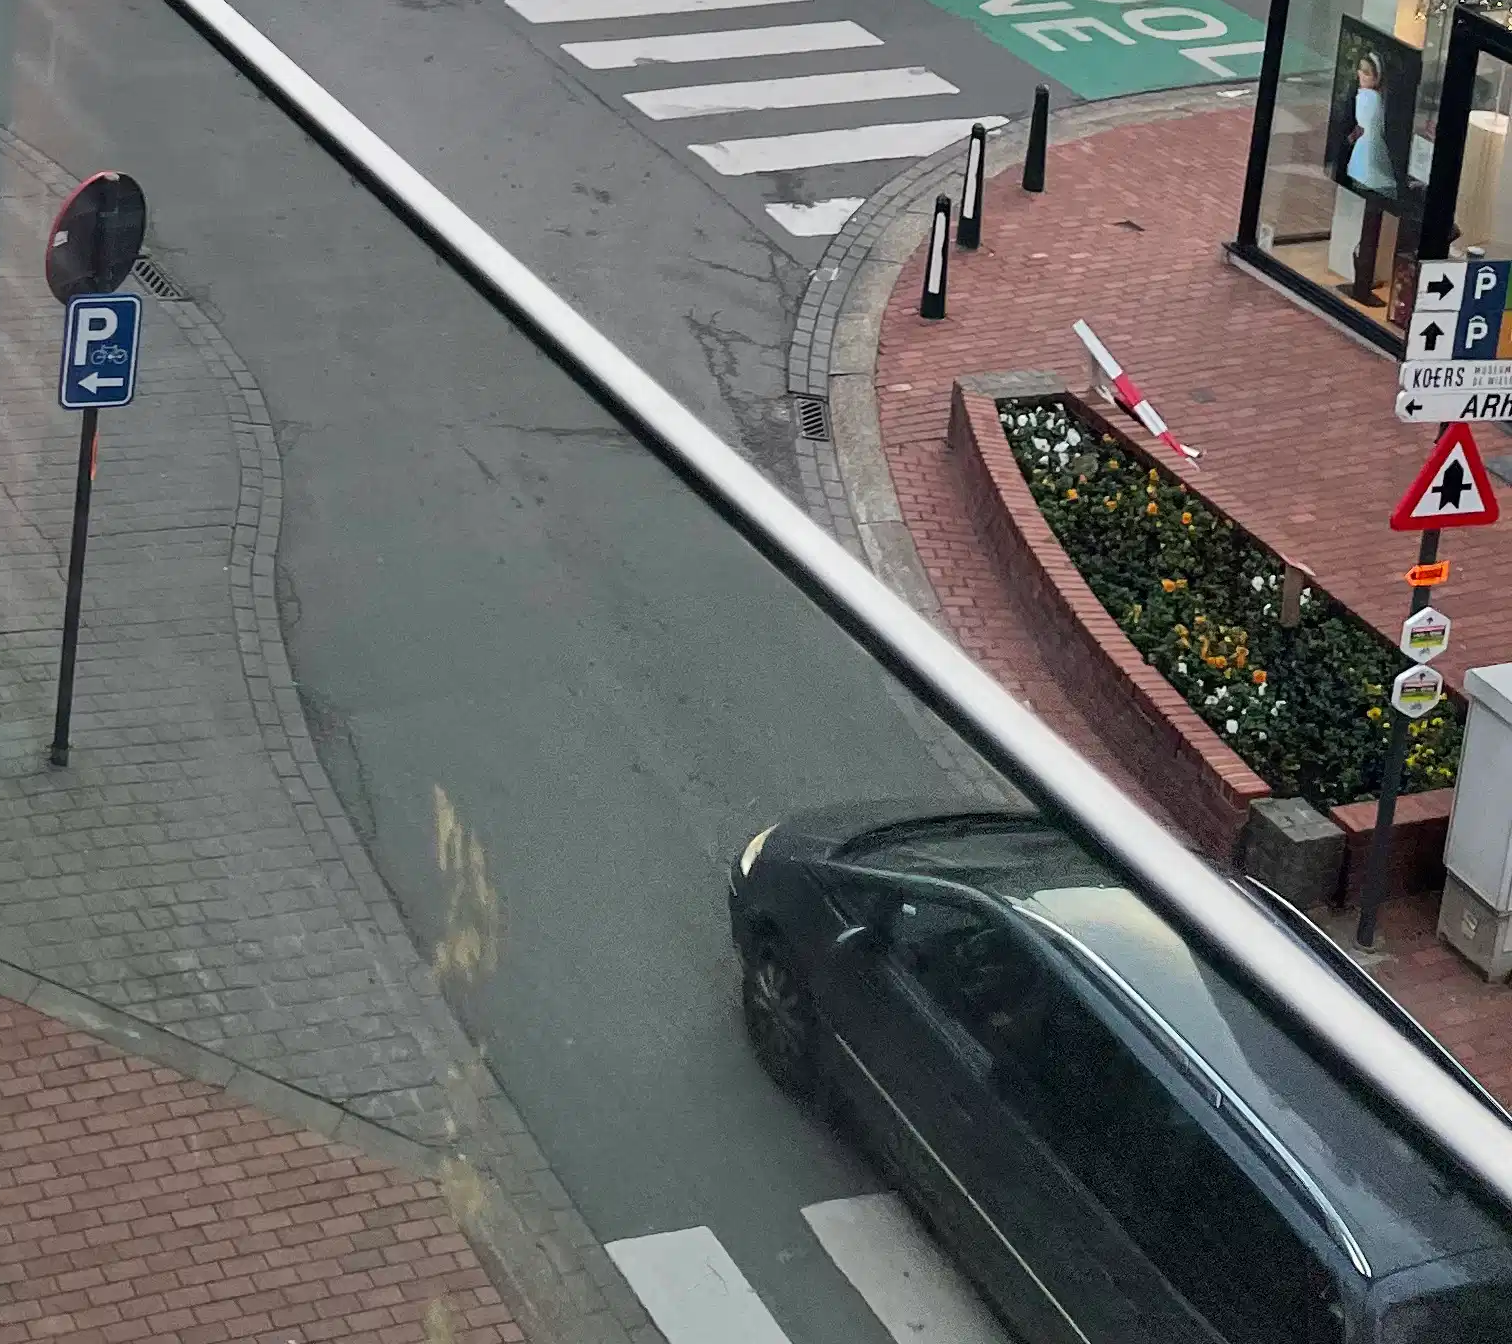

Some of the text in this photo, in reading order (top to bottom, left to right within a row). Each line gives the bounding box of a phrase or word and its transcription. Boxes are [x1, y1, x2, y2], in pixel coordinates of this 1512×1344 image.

[1474, 271, 1497, 300] P
[74, 307, 118, 366] P
[1465, 321, 1489, 350] P
[1412, 367, 1466, 389] KOERS
